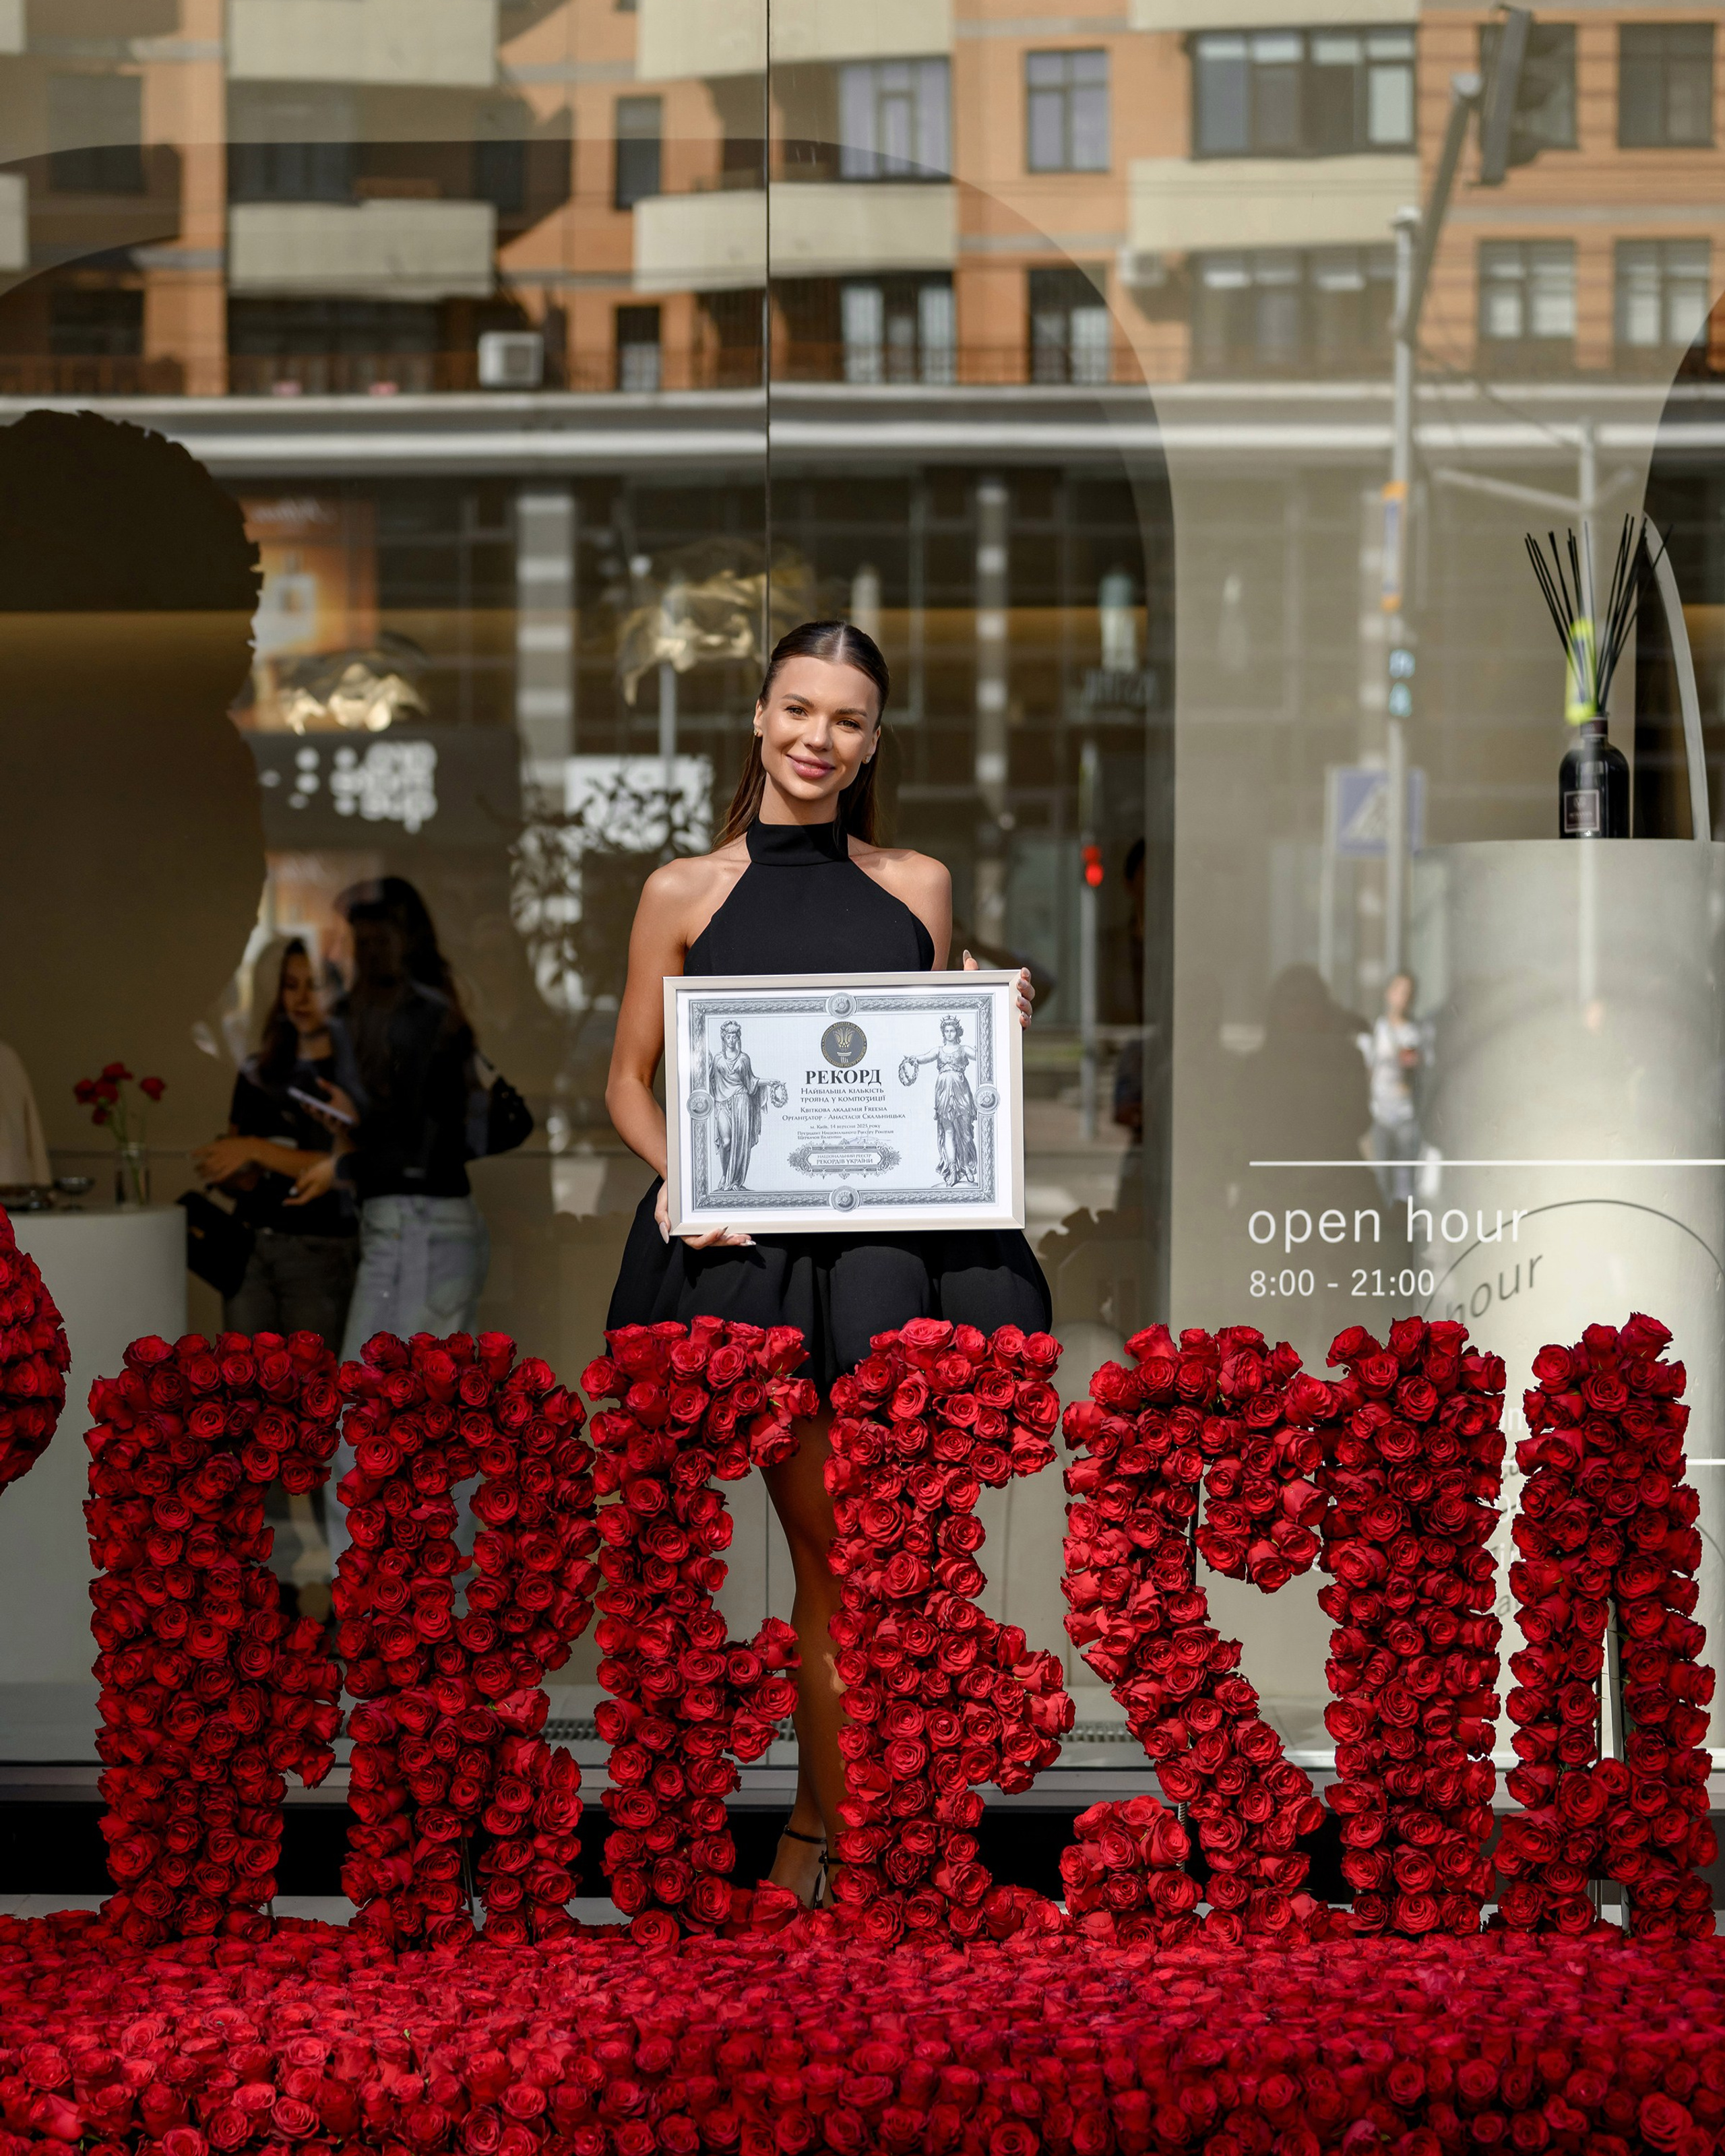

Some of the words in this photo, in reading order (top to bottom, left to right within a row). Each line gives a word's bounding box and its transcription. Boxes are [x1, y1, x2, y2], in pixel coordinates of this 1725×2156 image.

[805, 1069, 882, 1086] РЕКОРД
[1247, 1208, 1381, 1254] open
[1406, 1195, 1529, 1244] hour
[1249, 1269, 1315, 1298] 8:00
[1350, 1268, 1435, 1297] 21:00
